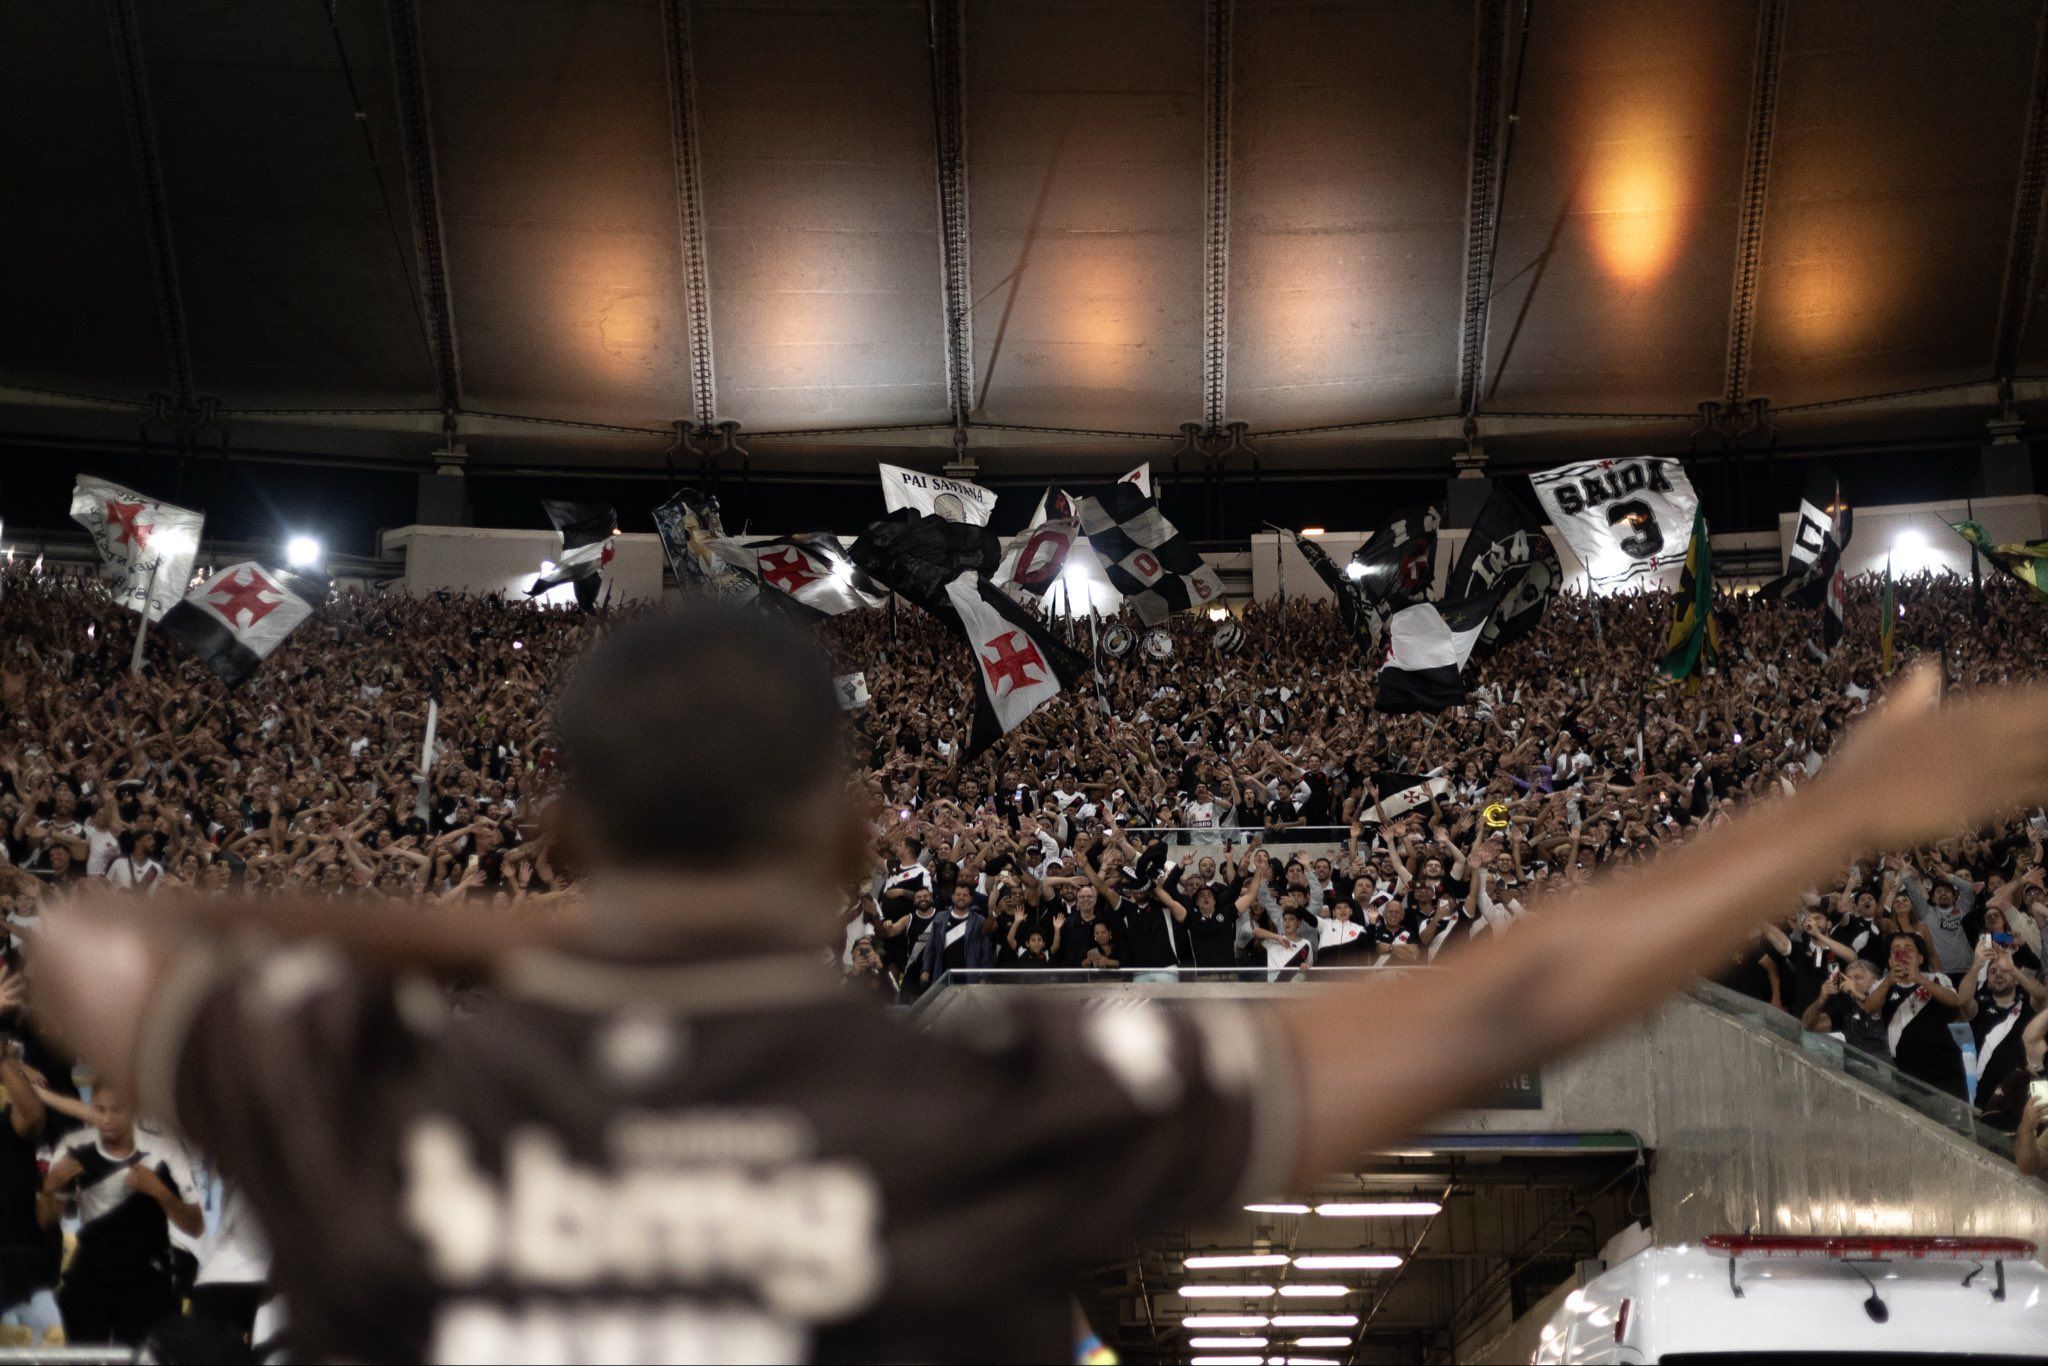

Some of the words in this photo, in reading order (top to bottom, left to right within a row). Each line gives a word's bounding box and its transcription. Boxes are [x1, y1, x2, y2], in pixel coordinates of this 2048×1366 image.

[901, 472, 927, 489] PAI
[932, 478, 983, 502] SANTANA
[1606, 498, 1665, 560] 3
